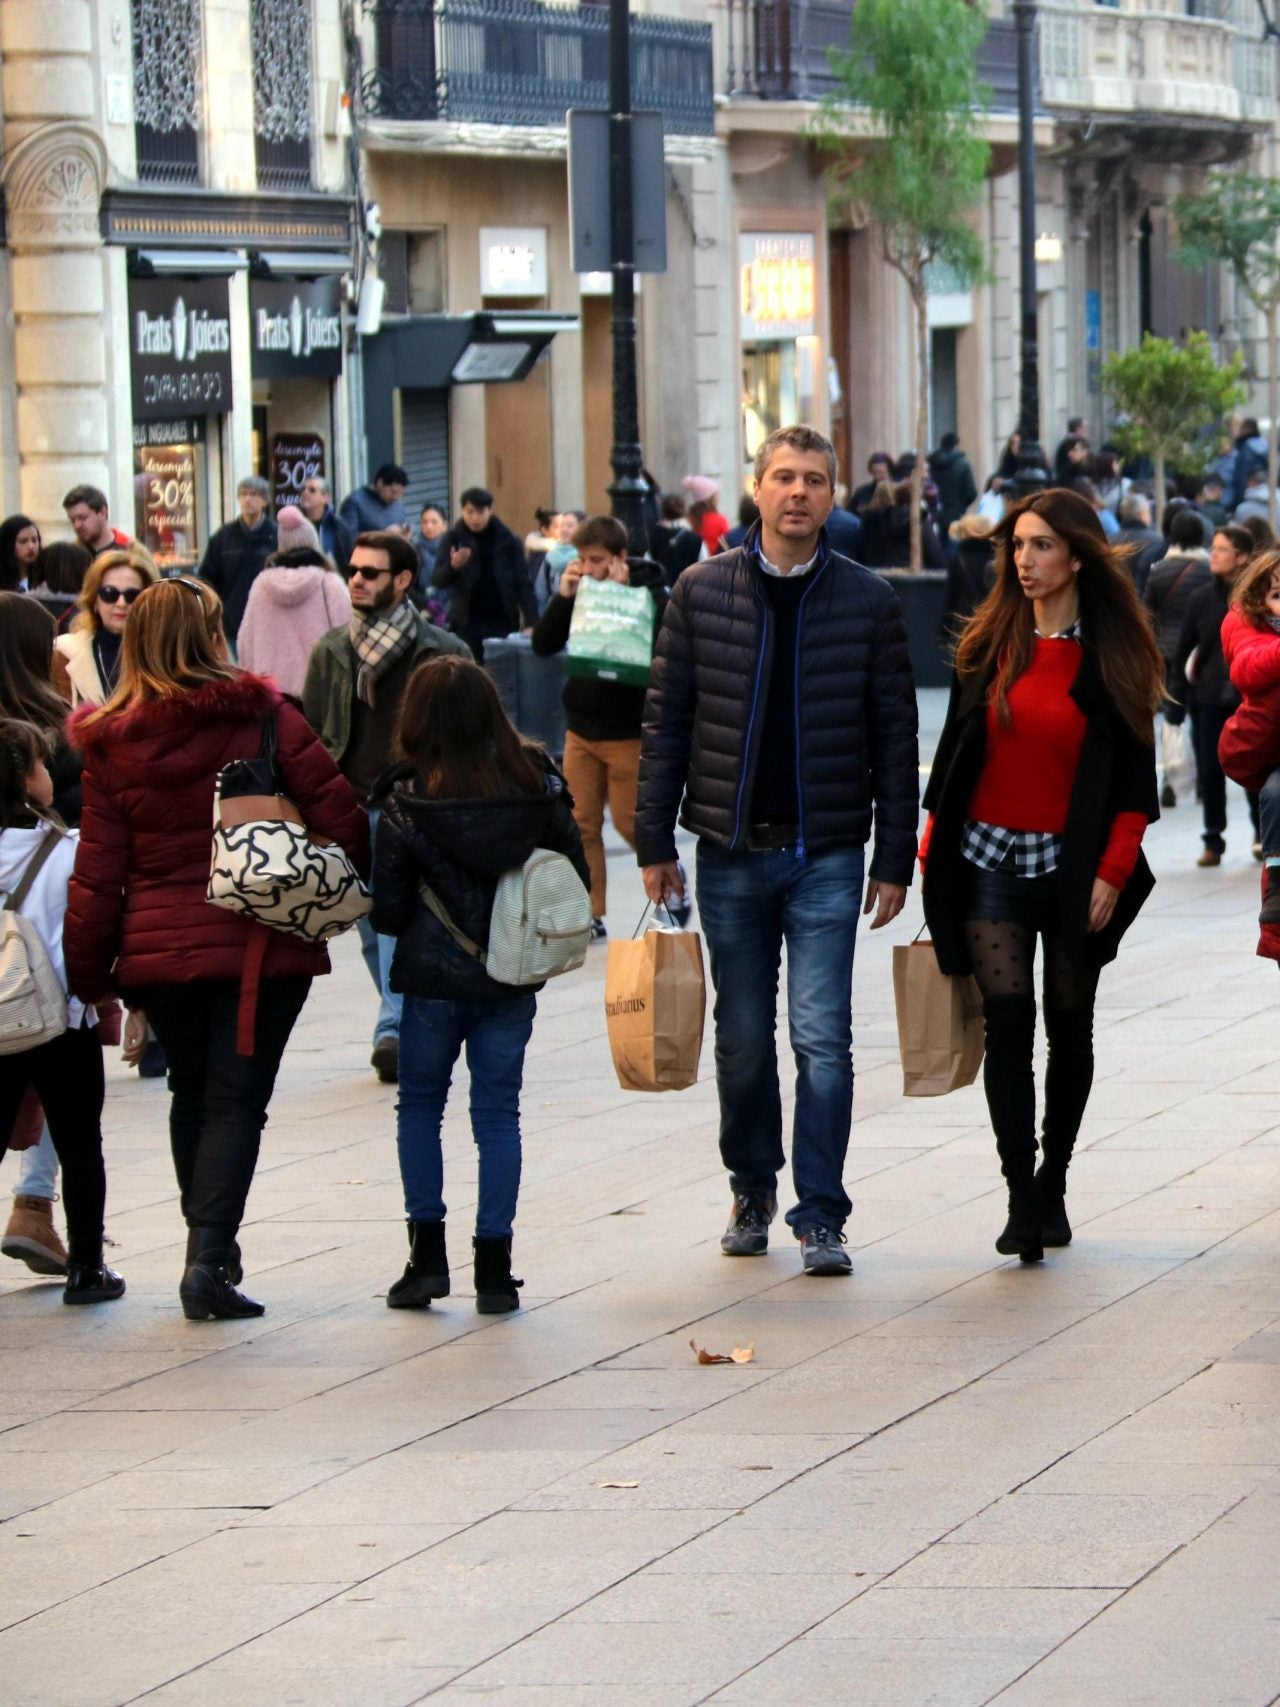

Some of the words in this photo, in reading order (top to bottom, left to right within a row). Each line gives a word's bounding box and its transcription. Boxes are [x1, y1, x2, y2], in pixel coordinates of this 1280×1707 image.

[137, 310, 172, 353] Prats
[188, 309, 229, 361] Joiers
[257, 308, 290, 349] Prats
[303, 307, 340, 357] Joiers
[276, 460, 321, 489] 30%
[148, 479, 193, 509] 30%
[149, 511, 192, 533] especial
